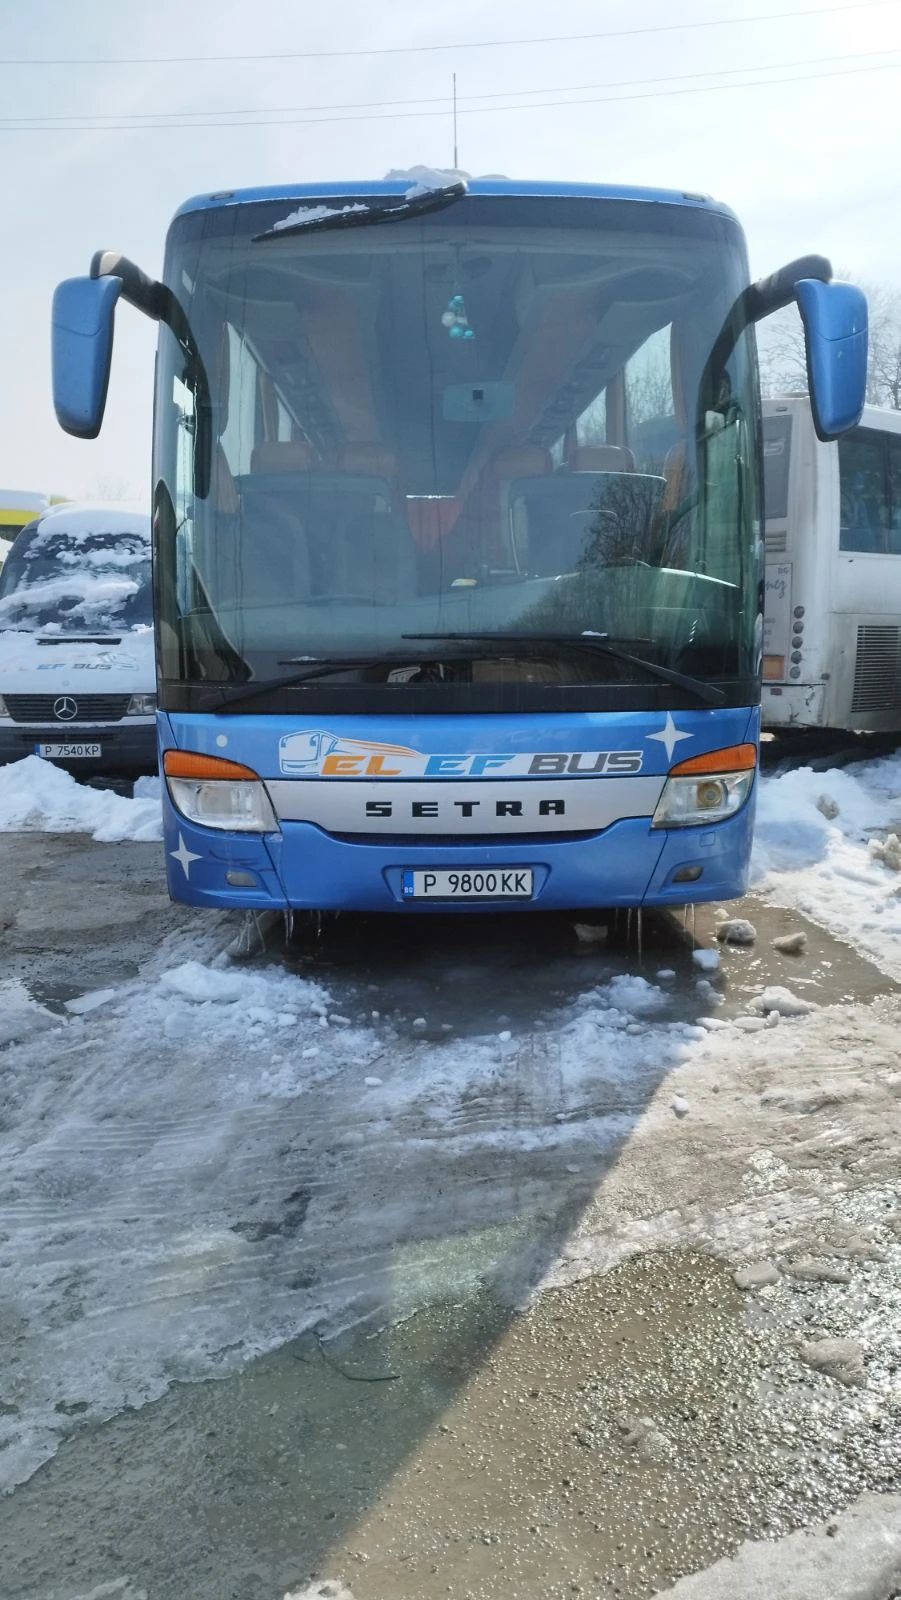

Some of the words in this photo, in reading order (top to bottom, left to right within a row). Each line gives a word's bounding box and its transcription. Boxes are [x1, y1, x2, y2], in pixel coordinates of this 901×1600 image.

[45, 745, 52, 756] P
[57, 745, 99, 756] 7540KP
[321, 755, 401, 775] EL
[424, 755, 516, 775] EF
[528, 752, 642, 774] BUS
[365, 800, 565, 817] SETRA
[424, 874, 437, 893] P
[448, 873, 527, 893] 9800KK
